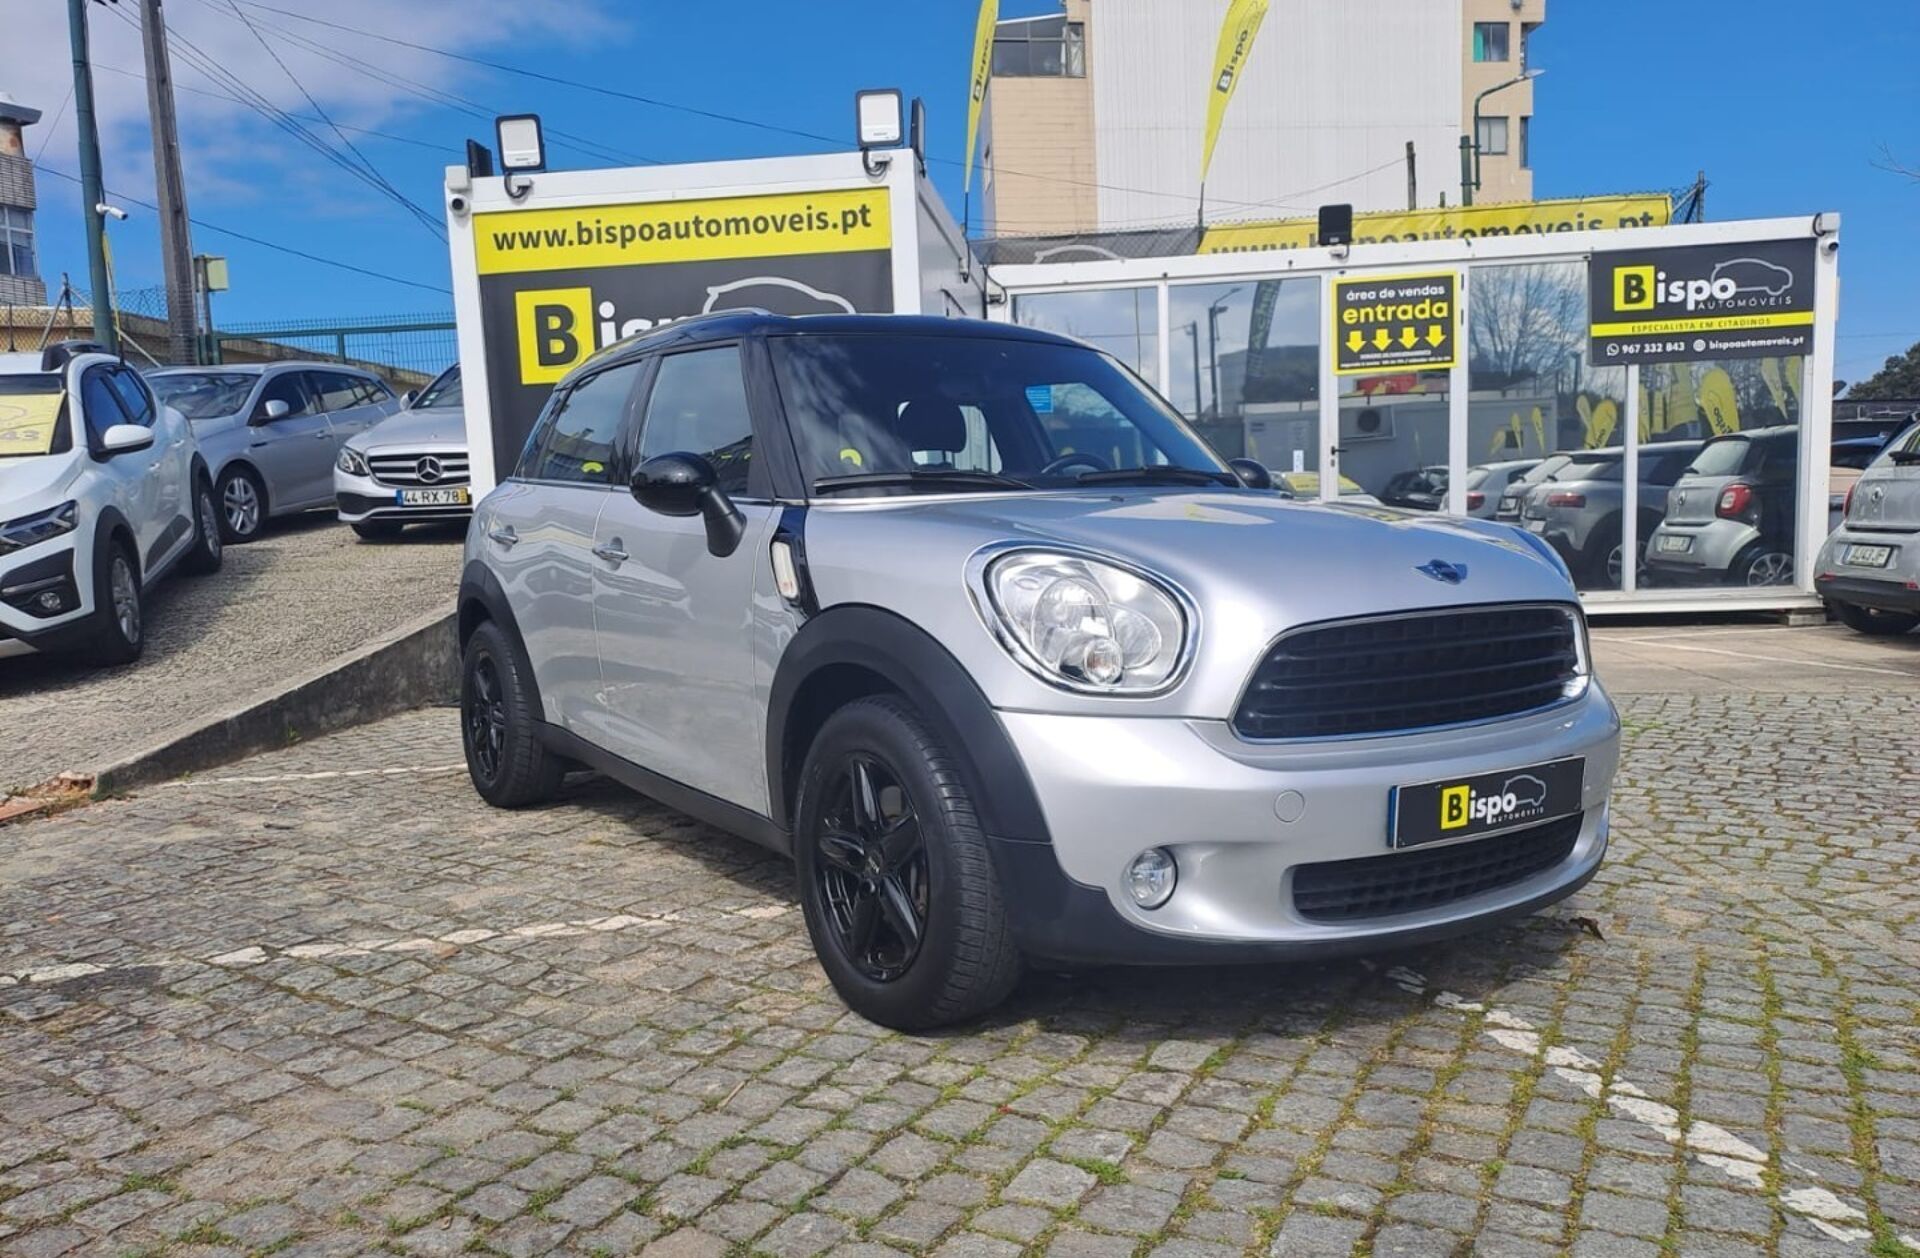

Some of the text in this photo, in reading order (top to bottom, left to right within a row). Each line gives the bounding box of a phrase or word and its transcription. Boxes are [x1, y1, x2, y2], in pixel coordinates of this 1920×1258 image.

[1216, 29, 1248, 93] Bispo
[493, 203, 872, 250] www.bispoautomoveis.pt
[1346, 284, 1446, 301] área de vendas
[1622, 271, 1737, 311] Bispo
[1698, 296, 1793, 311] AUTOMÓVEIS
[1342, 298, 1449, 325] entrada
[1631, 317, 1771, 333] ESPECIALISTA EM CITADINOS
[1622, 344, 1641, 355] 967
[1644, 342, 1664, 354] 332
[1666, 341, 1686, 352] 843
[1447, 789, 1517, 825] Bispo
